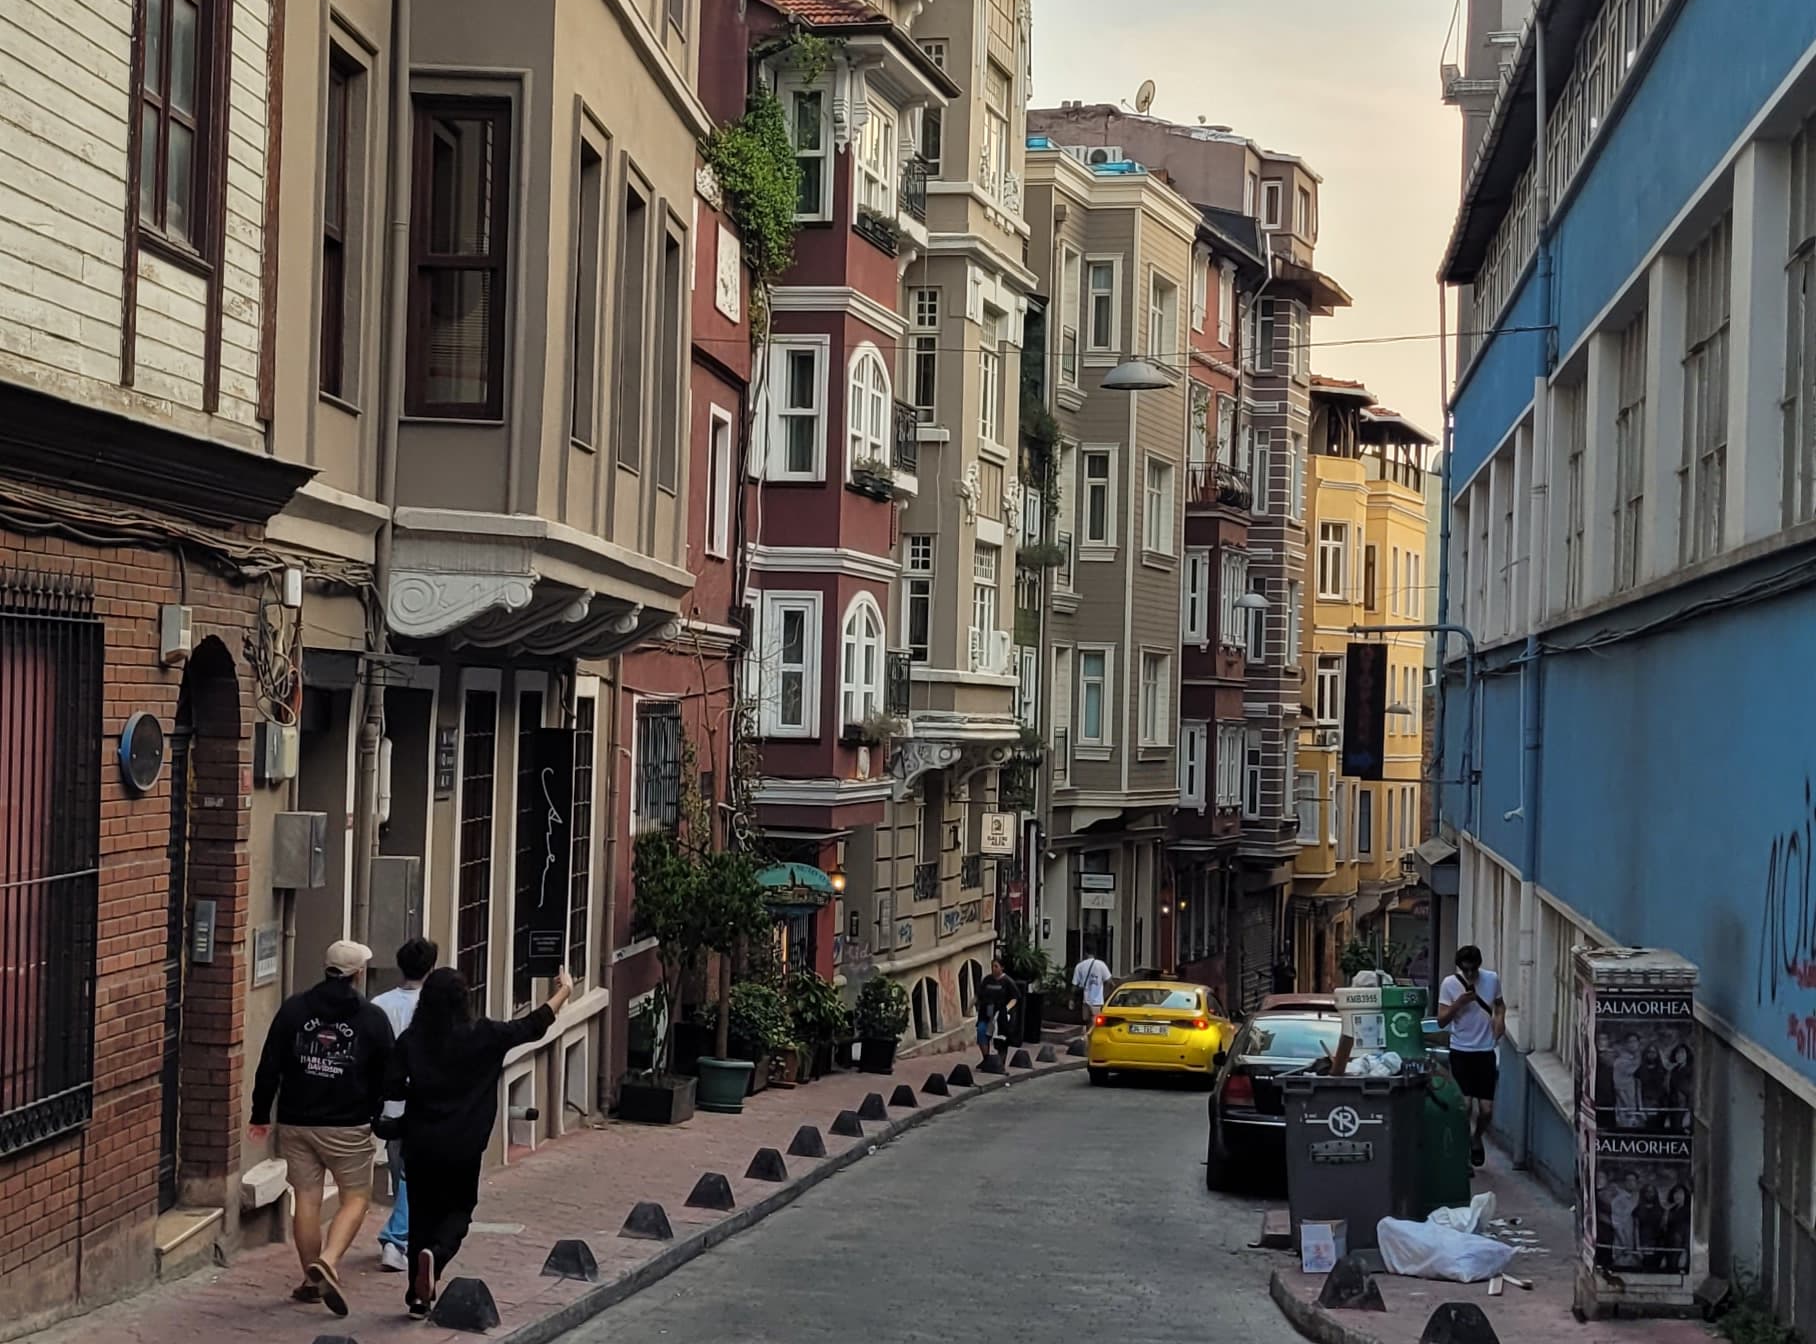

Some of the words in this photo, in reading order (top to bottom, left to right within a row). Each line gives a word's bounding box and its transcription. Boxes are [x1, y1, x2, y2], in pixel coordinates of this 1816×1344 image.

[1594, 1000, 1691, 1015] BALMORHEA
[303, 1017, 354, 1038] CHGO
[1594, 1138, 1690, 1155] BALMORHEA
